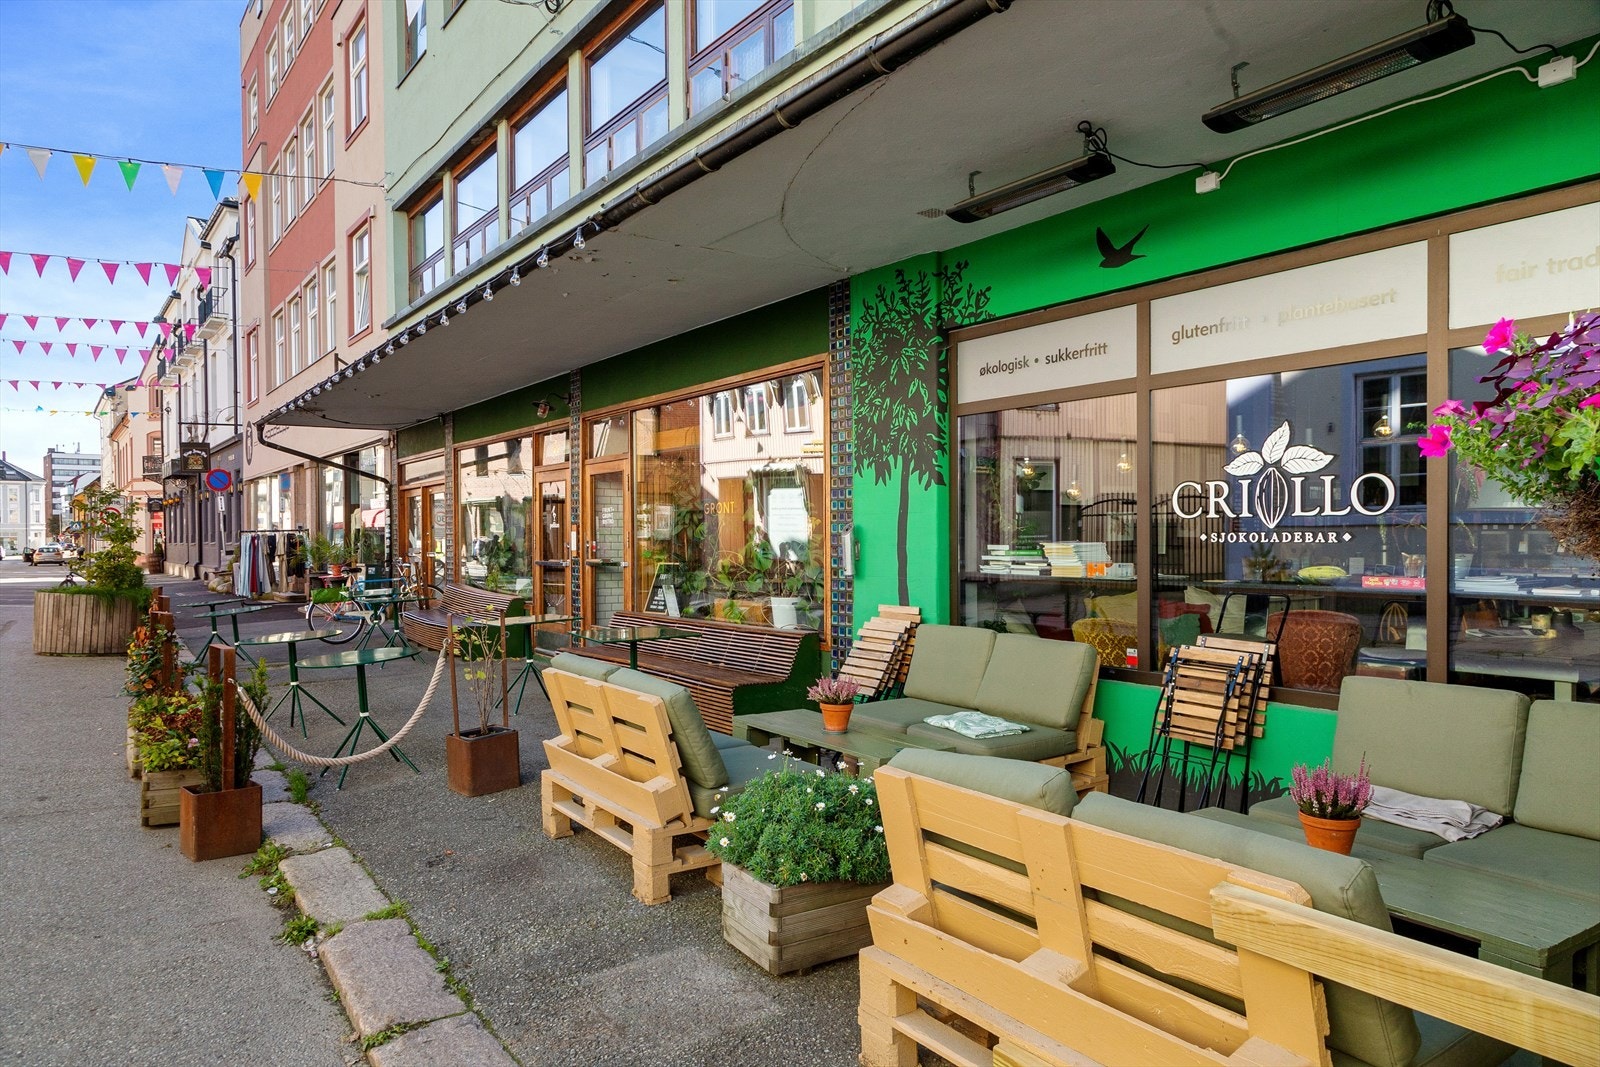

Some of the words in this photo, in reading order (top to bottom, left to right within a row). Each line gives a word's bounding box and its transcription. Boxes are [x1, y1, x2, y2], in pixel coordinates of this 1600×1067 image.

[1495, 261, 1538, 284] fair
[1171, 314, 1249, 345] glutenfritt
[1278, 288, 1398, 327] plantebasert
[979, 355, 1030, 377] økologisk
[1045, 342, 1108, 365] sukkerfritt
[1171, 472, 1396, 525] CRIOLLO
[1210, 532, 1339, 544] SJOKOLADEBAR
